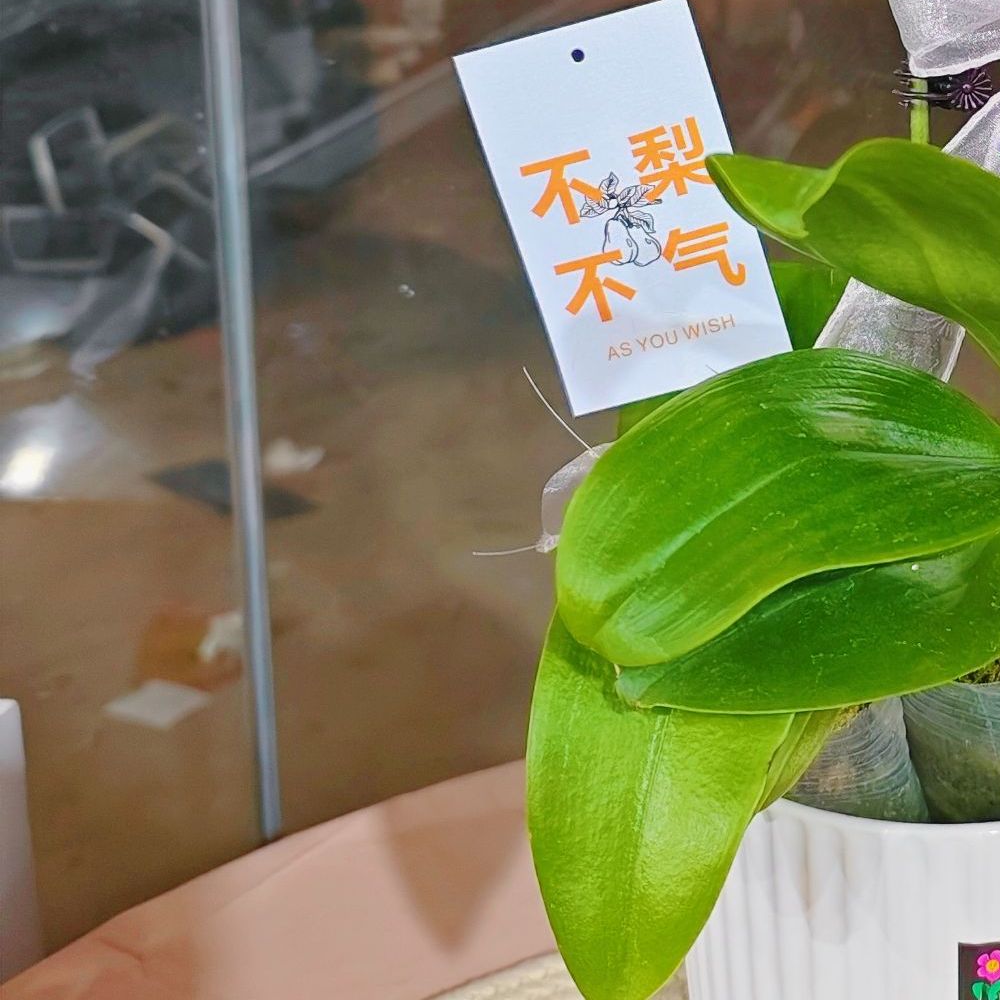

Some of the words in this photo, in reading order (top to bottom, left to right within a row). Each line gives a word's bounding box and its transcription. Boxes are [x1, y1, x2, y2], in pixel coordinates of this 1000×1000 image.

[554, 222, 747, 322] 不气
[606, 342, 633, 361] AS
[635, 329, 679, 352] YOU
[681, 314, 736, 340] WISH
